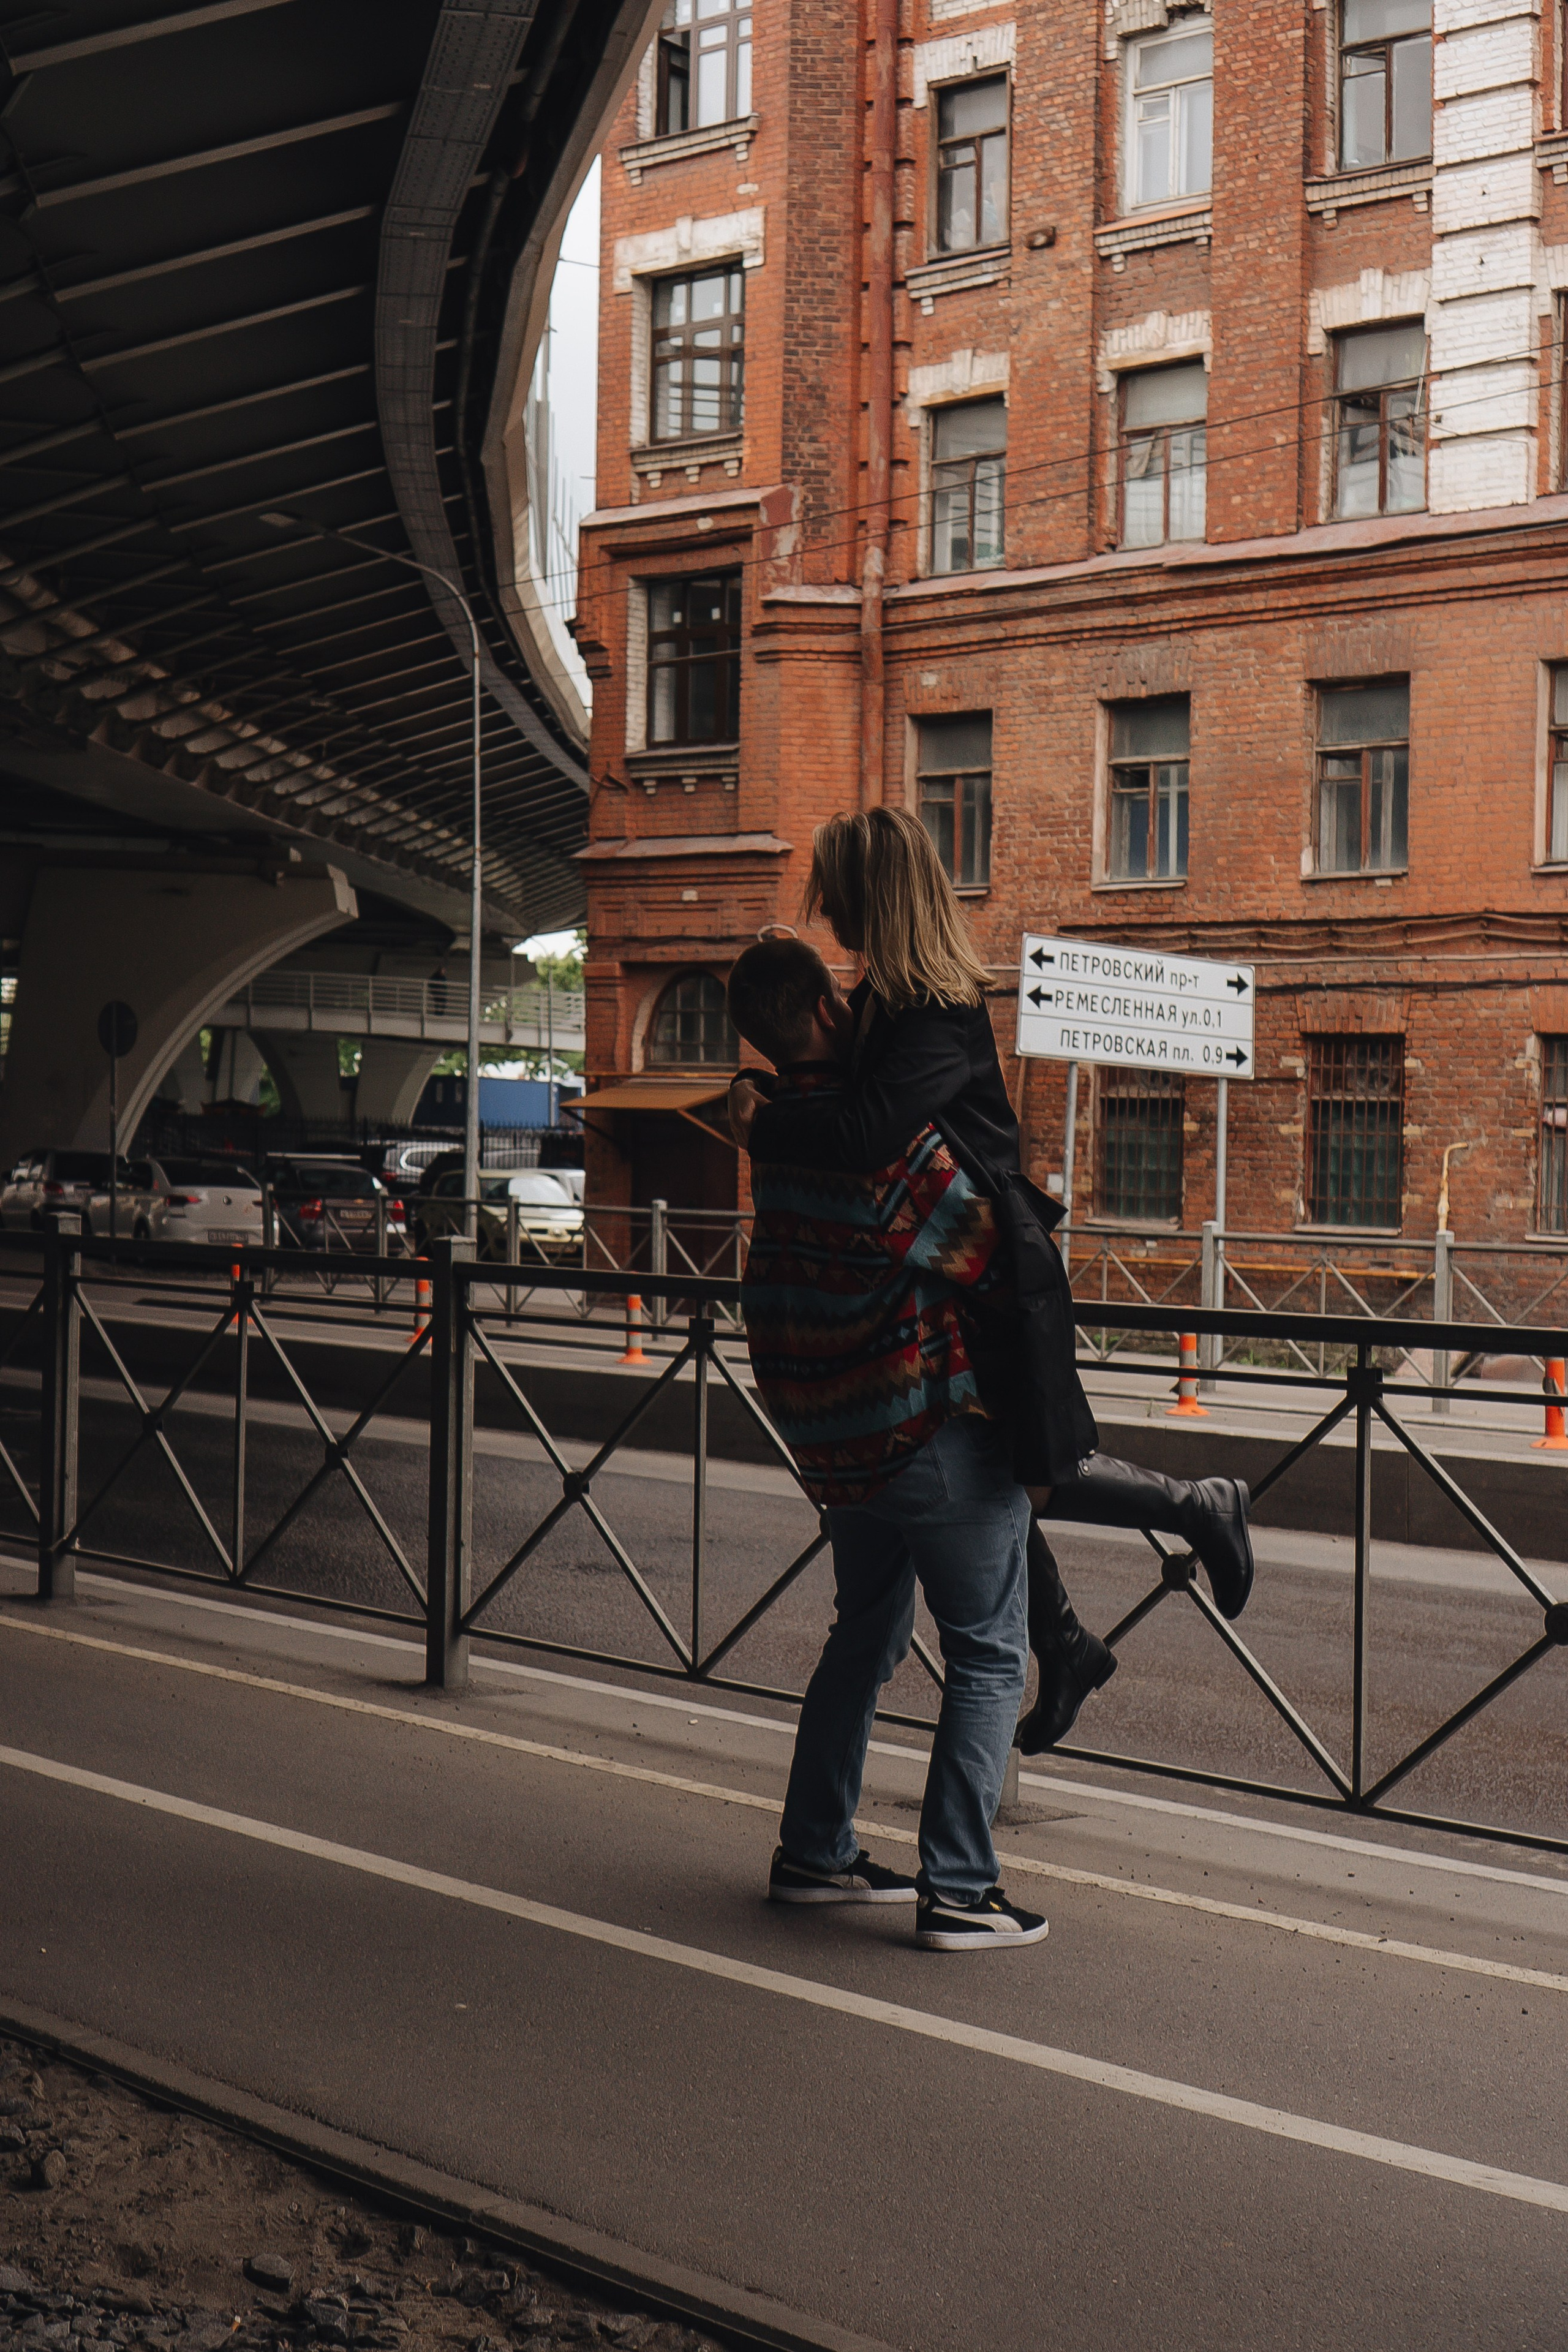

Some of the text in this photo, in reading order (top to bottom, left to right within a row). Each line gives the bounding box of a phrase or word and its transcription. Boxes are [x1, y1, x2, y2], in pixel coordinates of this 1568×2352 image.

[1060, 951, 1199, 990] ПЕТРОВСКИЙ пр-т
[1055, 989, 1177, 1023] РЕМЕСЛЕННАЯ
[1060, 1028, 1223, 1065] ПЕТРОВСКАЯ пл. 0,9
